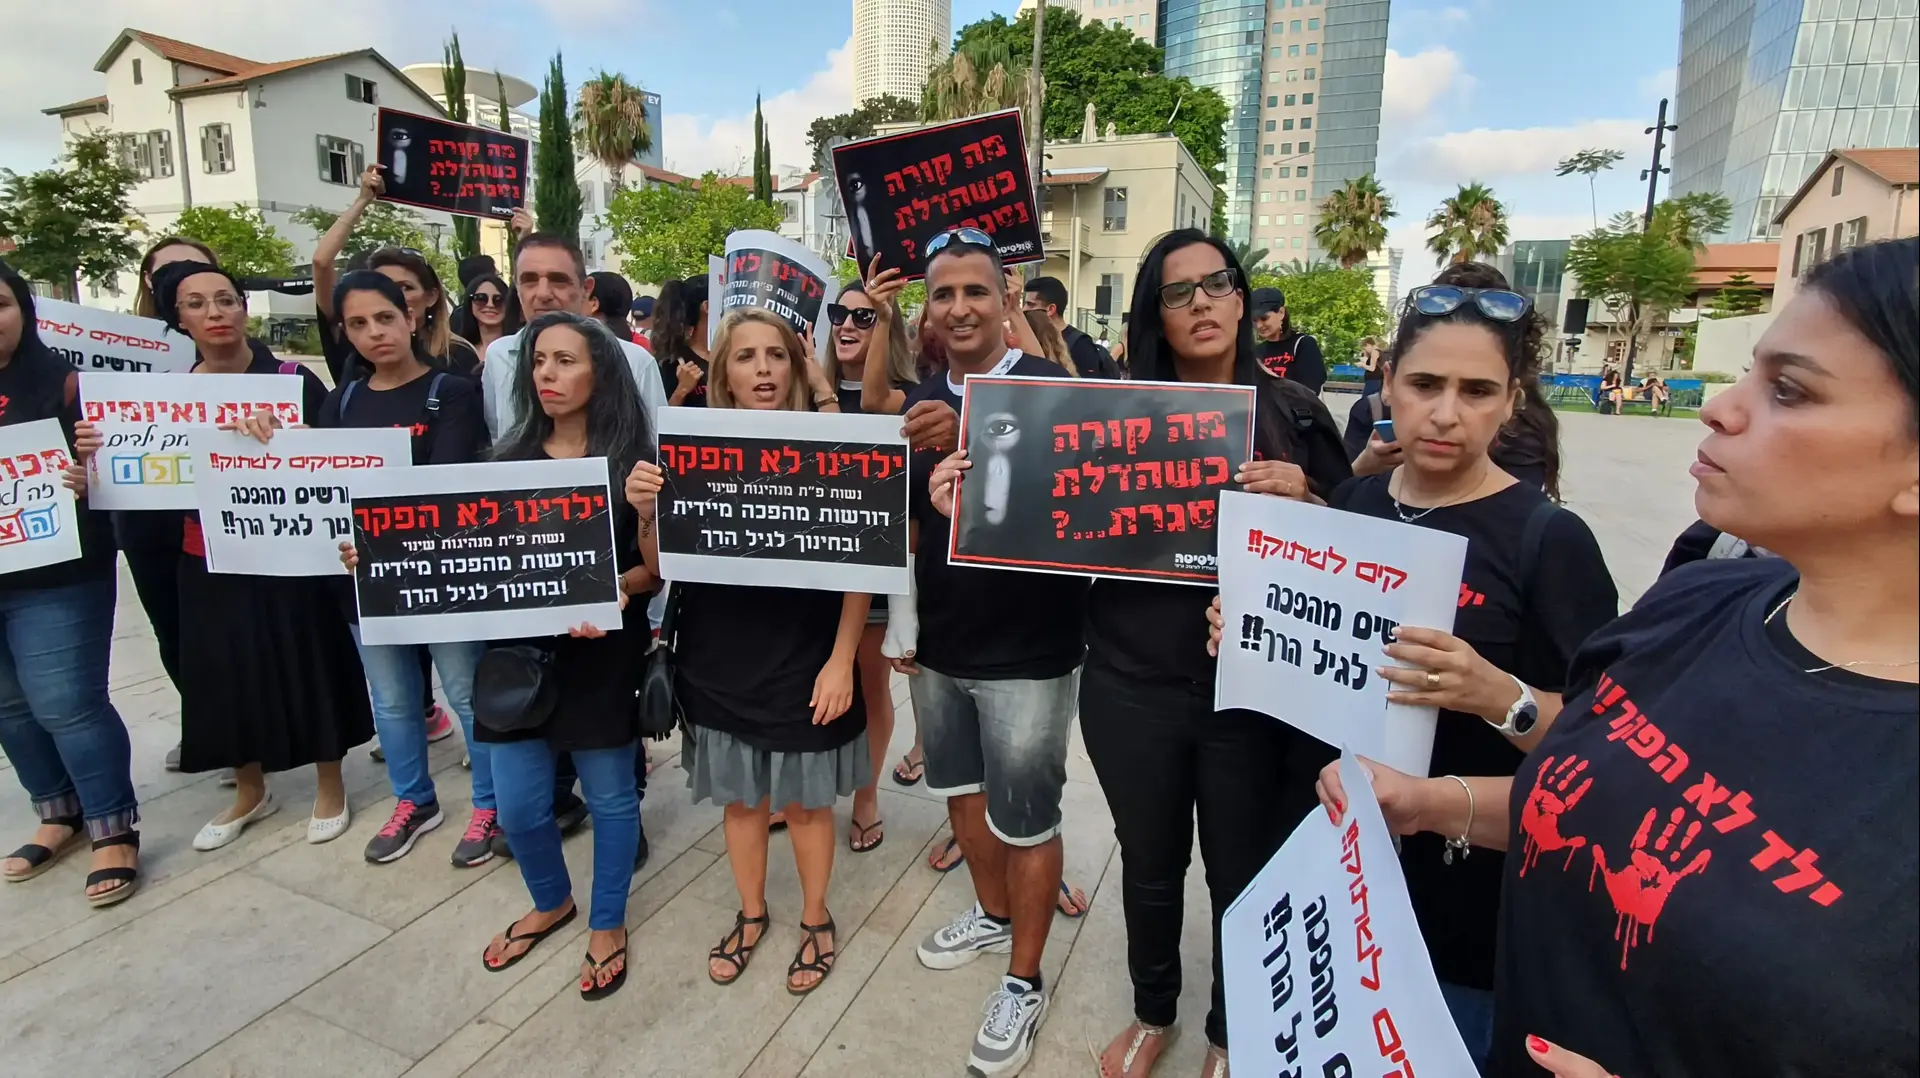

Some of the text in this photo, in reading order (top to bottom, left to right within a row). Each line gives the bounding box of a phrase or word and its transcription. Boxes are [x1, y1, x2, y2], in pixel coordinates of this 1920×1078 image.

[648, 96, 660, 104] EY
[428, 140, 516, 160] מה קורה
[430, 160, 517, 179] כשהדלת
[884, 134, 1007, 196] מה קורה
[894, 170, 1017, 231] כשהדלת
[947, 201, 1030, 234] נסג
[733, 252, 761, 273] לא
[776, 287, 799, 305] נשות
[36, 318, 170, 352] מפסיקים לשתו
[92, 354, 153, 373] דורשים
[85, 401, 207, 423] ואיומים
[107, 424, 158, 448] ילדים
[1053, 411, 1226, 455] מה קורה
[0, 448, 70, 482] מכו
[210, 452, 384, 472] מפסיקים לשתוק!!
[660, 444, 903, 479] ילדינו לא הפקר
[707, 482, 737, 494] שינוי
[1053, 456, 1229, 497] כשהדלת
[230, 486, 286, 505] מהפכה
[743, 483, 793, 496] מנהיגות
[830, 487, 862, 500] נשות
[221, 510, 264, 540] הרך!!
[270, 513, 313, 536] לגיל
[354, 493, 605, 537] ילדינו לא הפקר
[673, 500, 890, 527] דורשות מהפכה מיידית
[402, 540, 435, 552] שינוי
[441, 536, 493, 550] מנהיגות
[531, 532, 565, 545] נשות
[701, 529, 737, 549] הרך
[746, 530, 785, 548] לגיל
[370, 550, 596, 579] דורשות מהפכה מיידית
[1247, 528, 1408, 593] קים לשתוק!!
[400, 587, 438, 608] הרך
[446, 584, 488, 602] לגיל
[1266, 583, 1343, 631] מהפכה
[1240, 613, 1368, 690] לגיל הרך!!
[1682, 772, 1757, 834] לא
[1750, 830, 1844, 907] ילד
[1340, 817, 1383, 991] לשתוק!!
[1262, 892, 1293, 1013] הרך!!
[1303, 895, 1339, 1039] מהפכה
